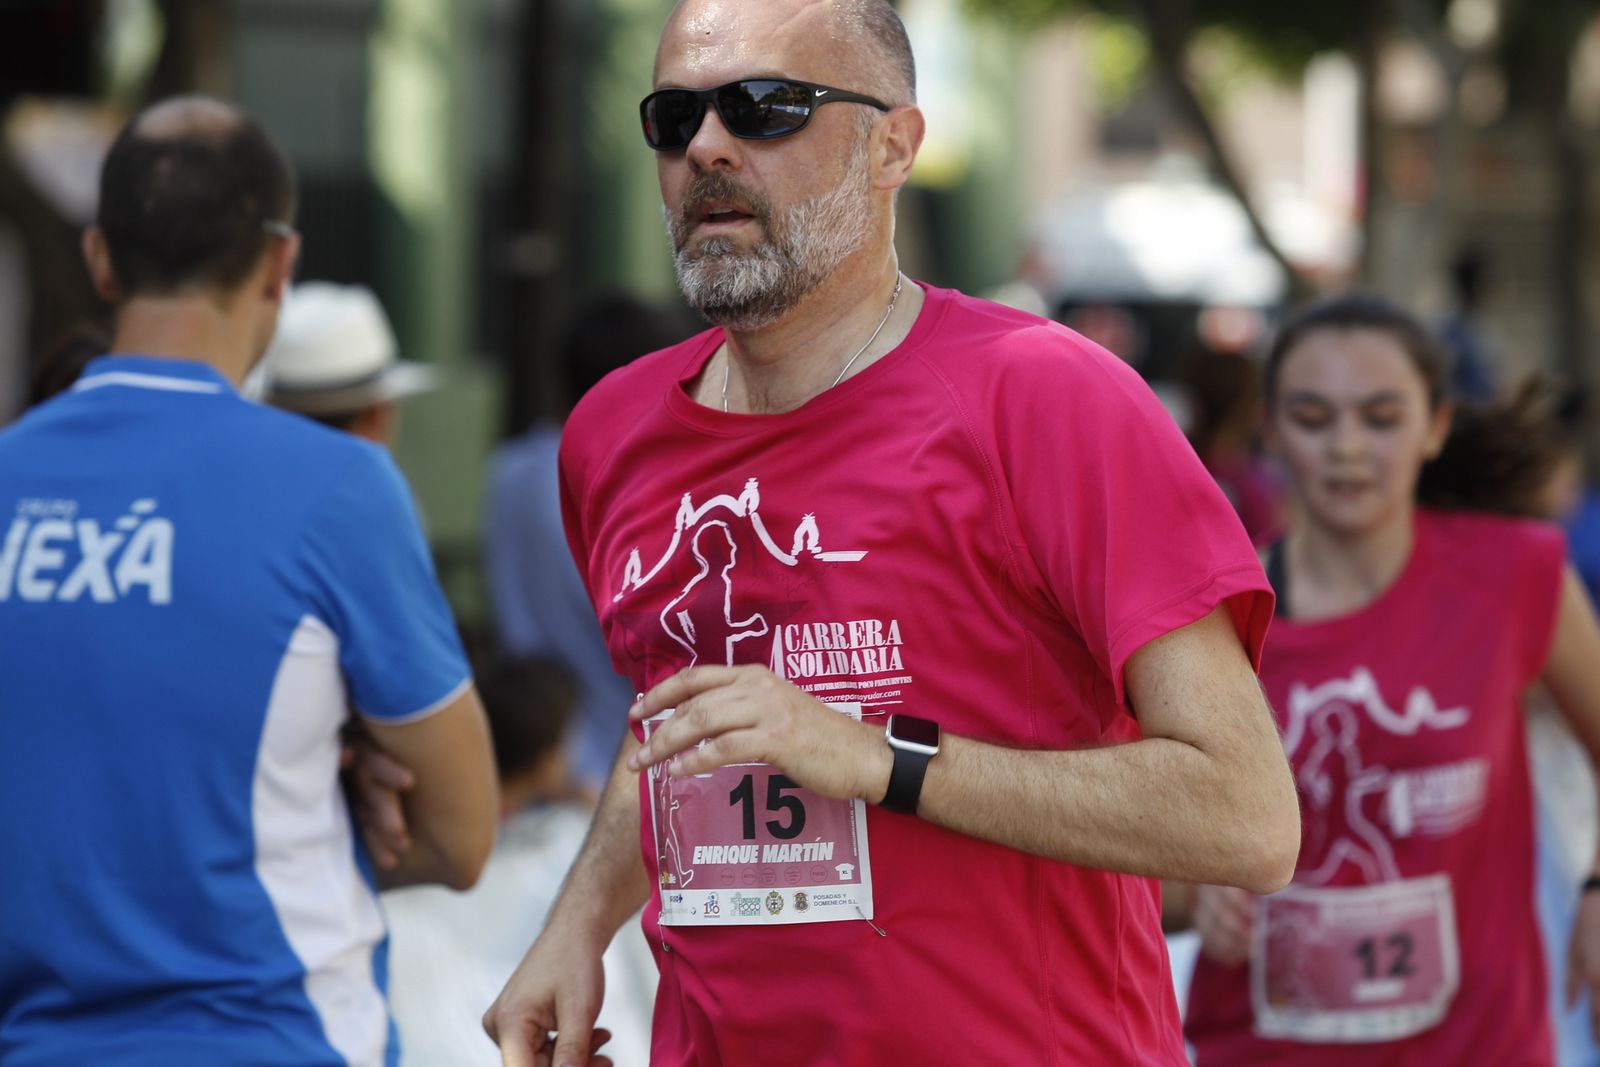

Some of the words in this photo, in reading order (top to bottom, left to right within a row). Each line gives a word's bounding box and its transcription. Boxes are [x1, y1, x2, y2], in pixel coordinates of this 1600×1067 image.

[784, 619, 904, 653] CARRERA
[786, 646, 904, 679] SOLIDARIA
[858, 680, 874, 689] POCO
[729, 773, 806, 841] 15
[692, 845, 760, 865] ENRIQUE
[762, 837, 834, 864] MARTÍN
[1352, 931, 1417, 979] 12
